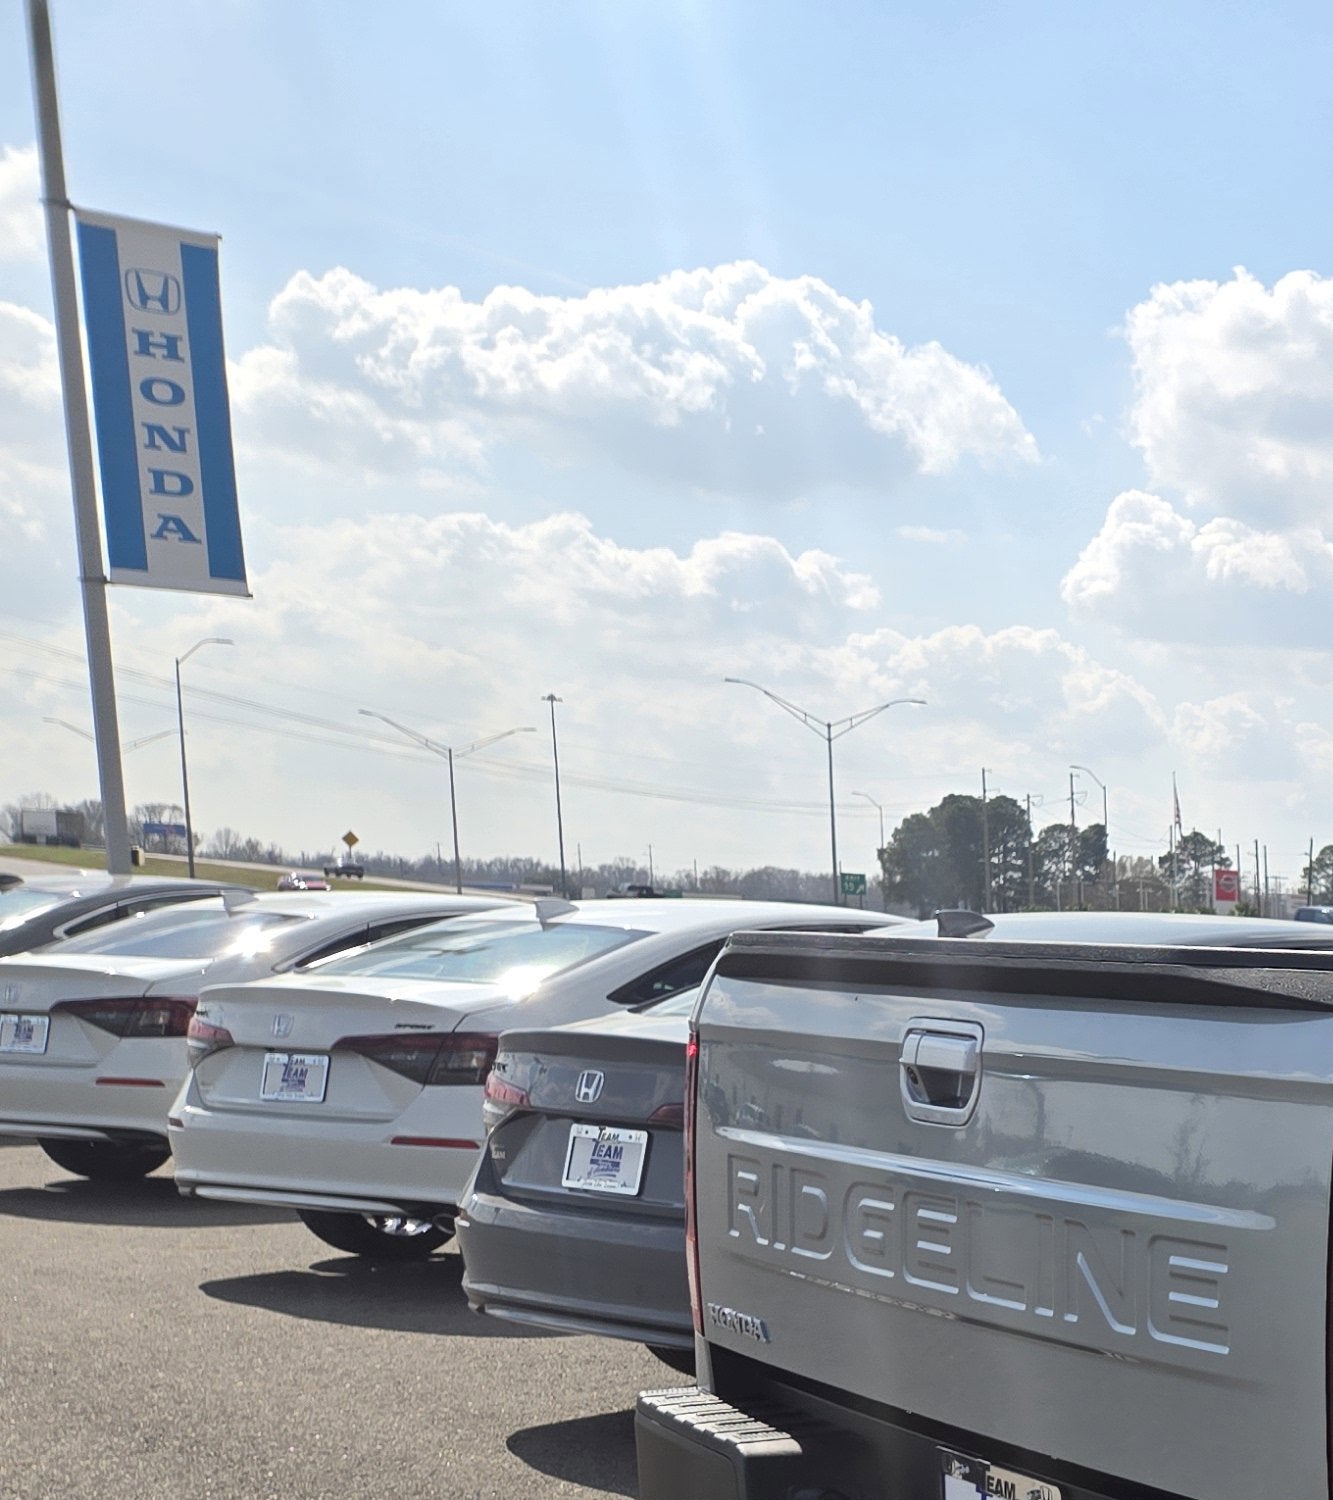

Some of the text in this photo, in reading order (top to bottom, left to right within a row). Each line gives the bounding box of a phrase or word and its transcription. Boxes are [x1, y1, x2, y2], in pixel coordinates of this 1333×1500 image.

[131, 326, 202, 544] HONDA
[592, 1138, 624, 1160] TEAM
[727, 1153, 1230, 1355] RIDGELINE
[707, 1302, 770, 1344] HONDA
